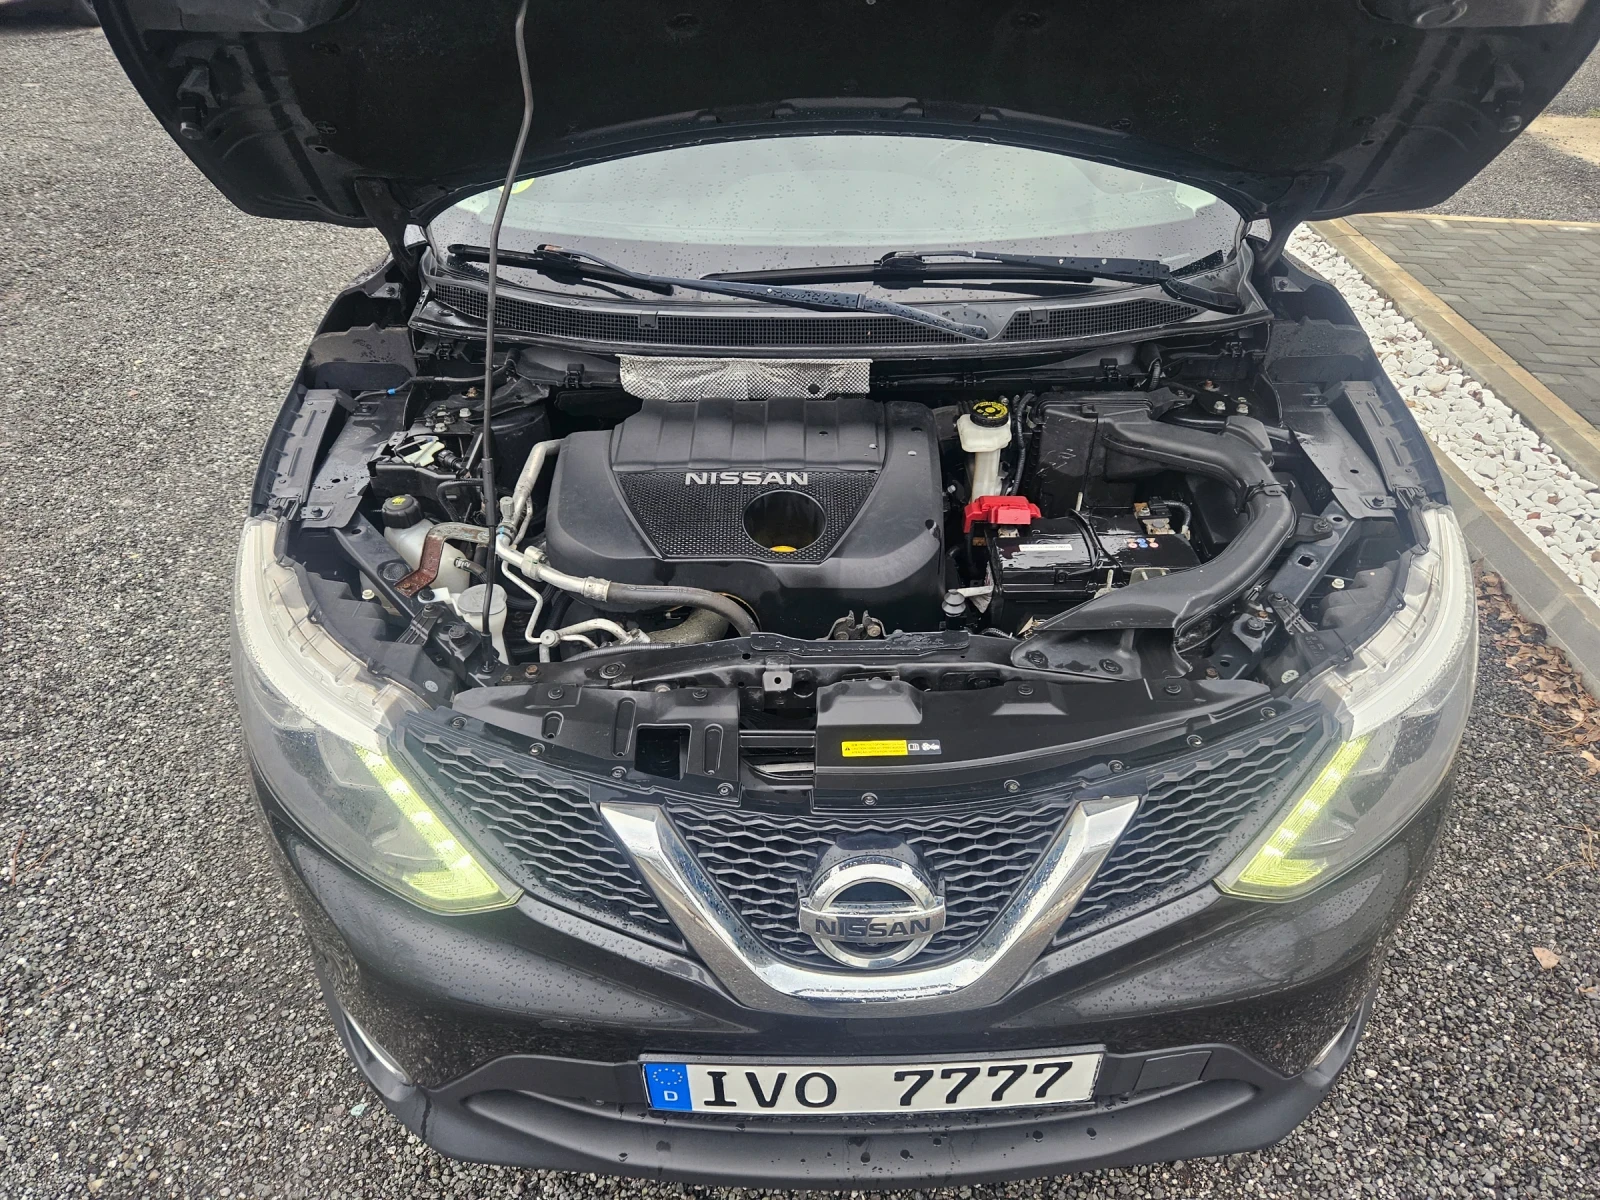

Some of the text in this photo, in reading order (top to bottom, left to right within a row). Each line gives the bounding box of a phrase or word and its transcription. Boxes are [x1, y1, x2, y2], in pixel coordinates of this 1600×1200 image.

[685, 472, 808, 485] NISSAN
[815, 917, 931, 938] NISSAN
[703, 1061, 1074, 1108] IVO 7777
[664, 1090, 679, 1102] D
